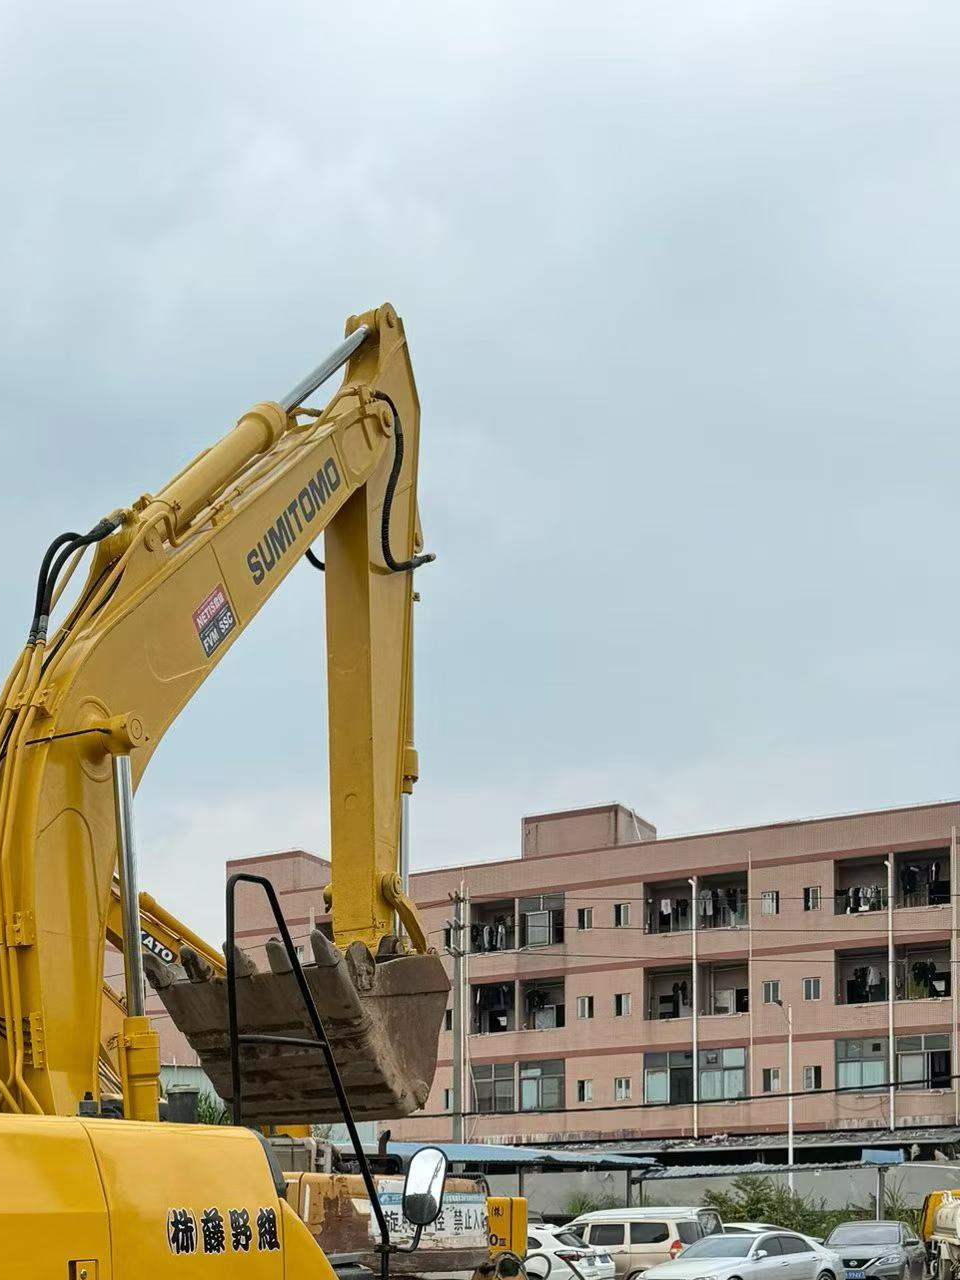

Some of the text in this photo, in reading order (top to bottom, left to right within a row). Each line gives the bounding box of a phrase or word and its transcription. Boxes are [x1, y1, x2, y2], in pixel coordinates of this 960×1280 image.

[246, 457, 341, 586] SUMITOMO
[203, 611, 233, 652] FVM SSC
[141, 930, 173, 961] ATO
